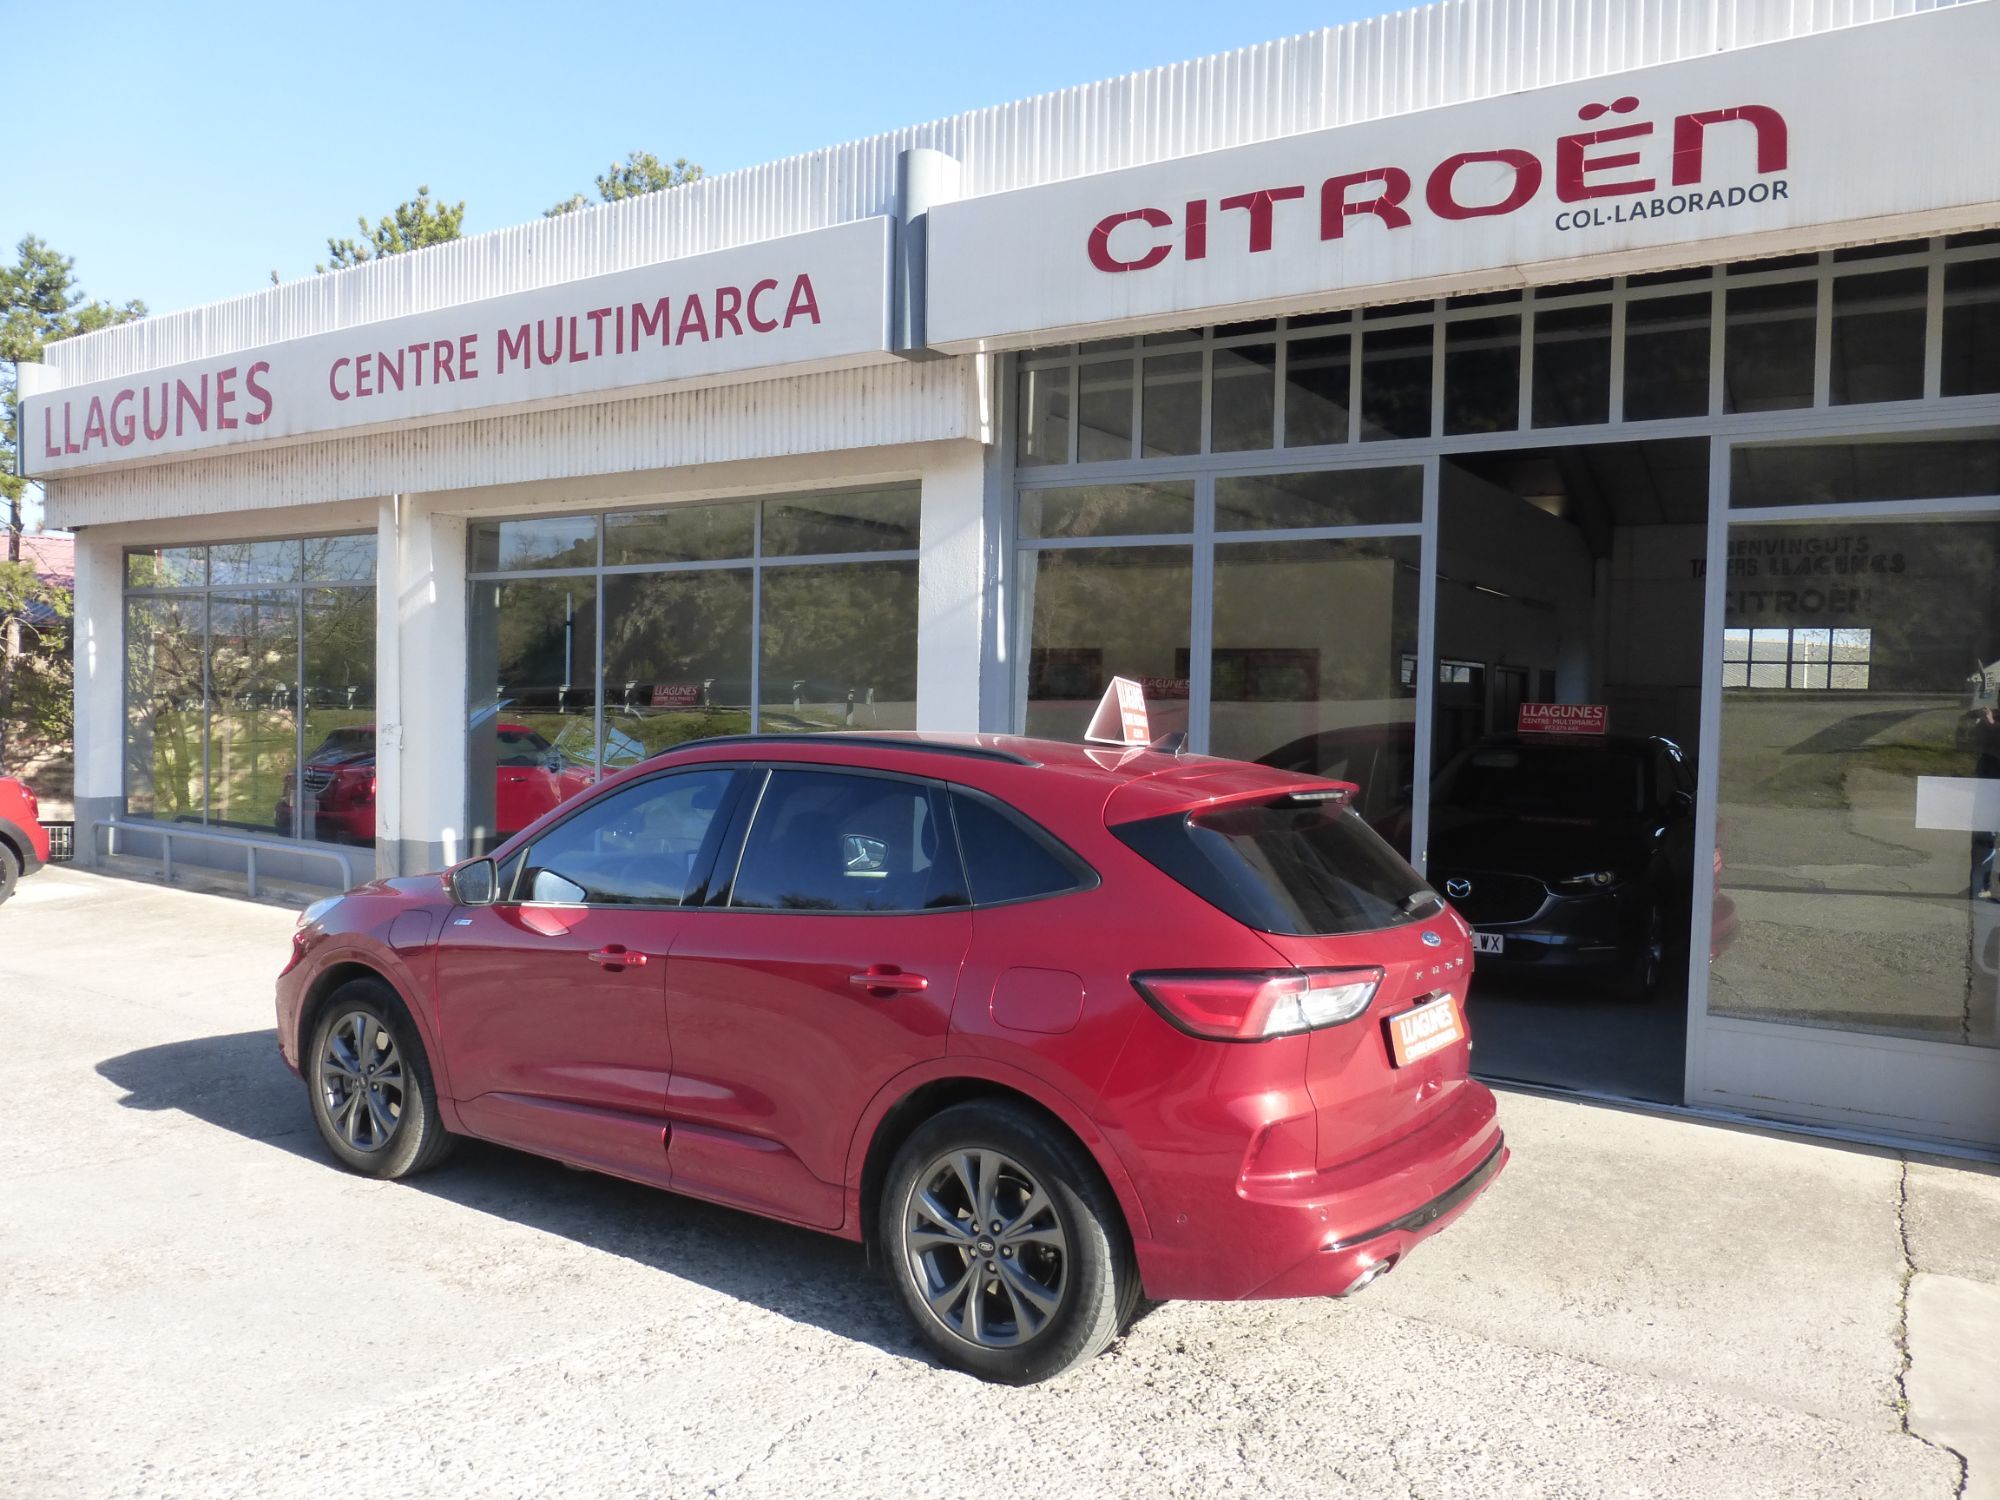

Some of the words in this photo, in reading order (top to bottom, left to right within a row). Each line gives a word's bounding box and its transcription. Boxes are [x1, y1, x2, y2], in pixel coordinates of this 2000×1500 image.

[45, 363, 273, 458] LLAGUNES
[330, 333, 479, 401] CENTRE
[497, 273, 822, 374] MULTIMARCA
[654, 685, 698, 696] LLAGUNES
[1522, 704, 1603, 719] LLAGUNES
[1552, 718, 1601, 726] MULTIMARCA
